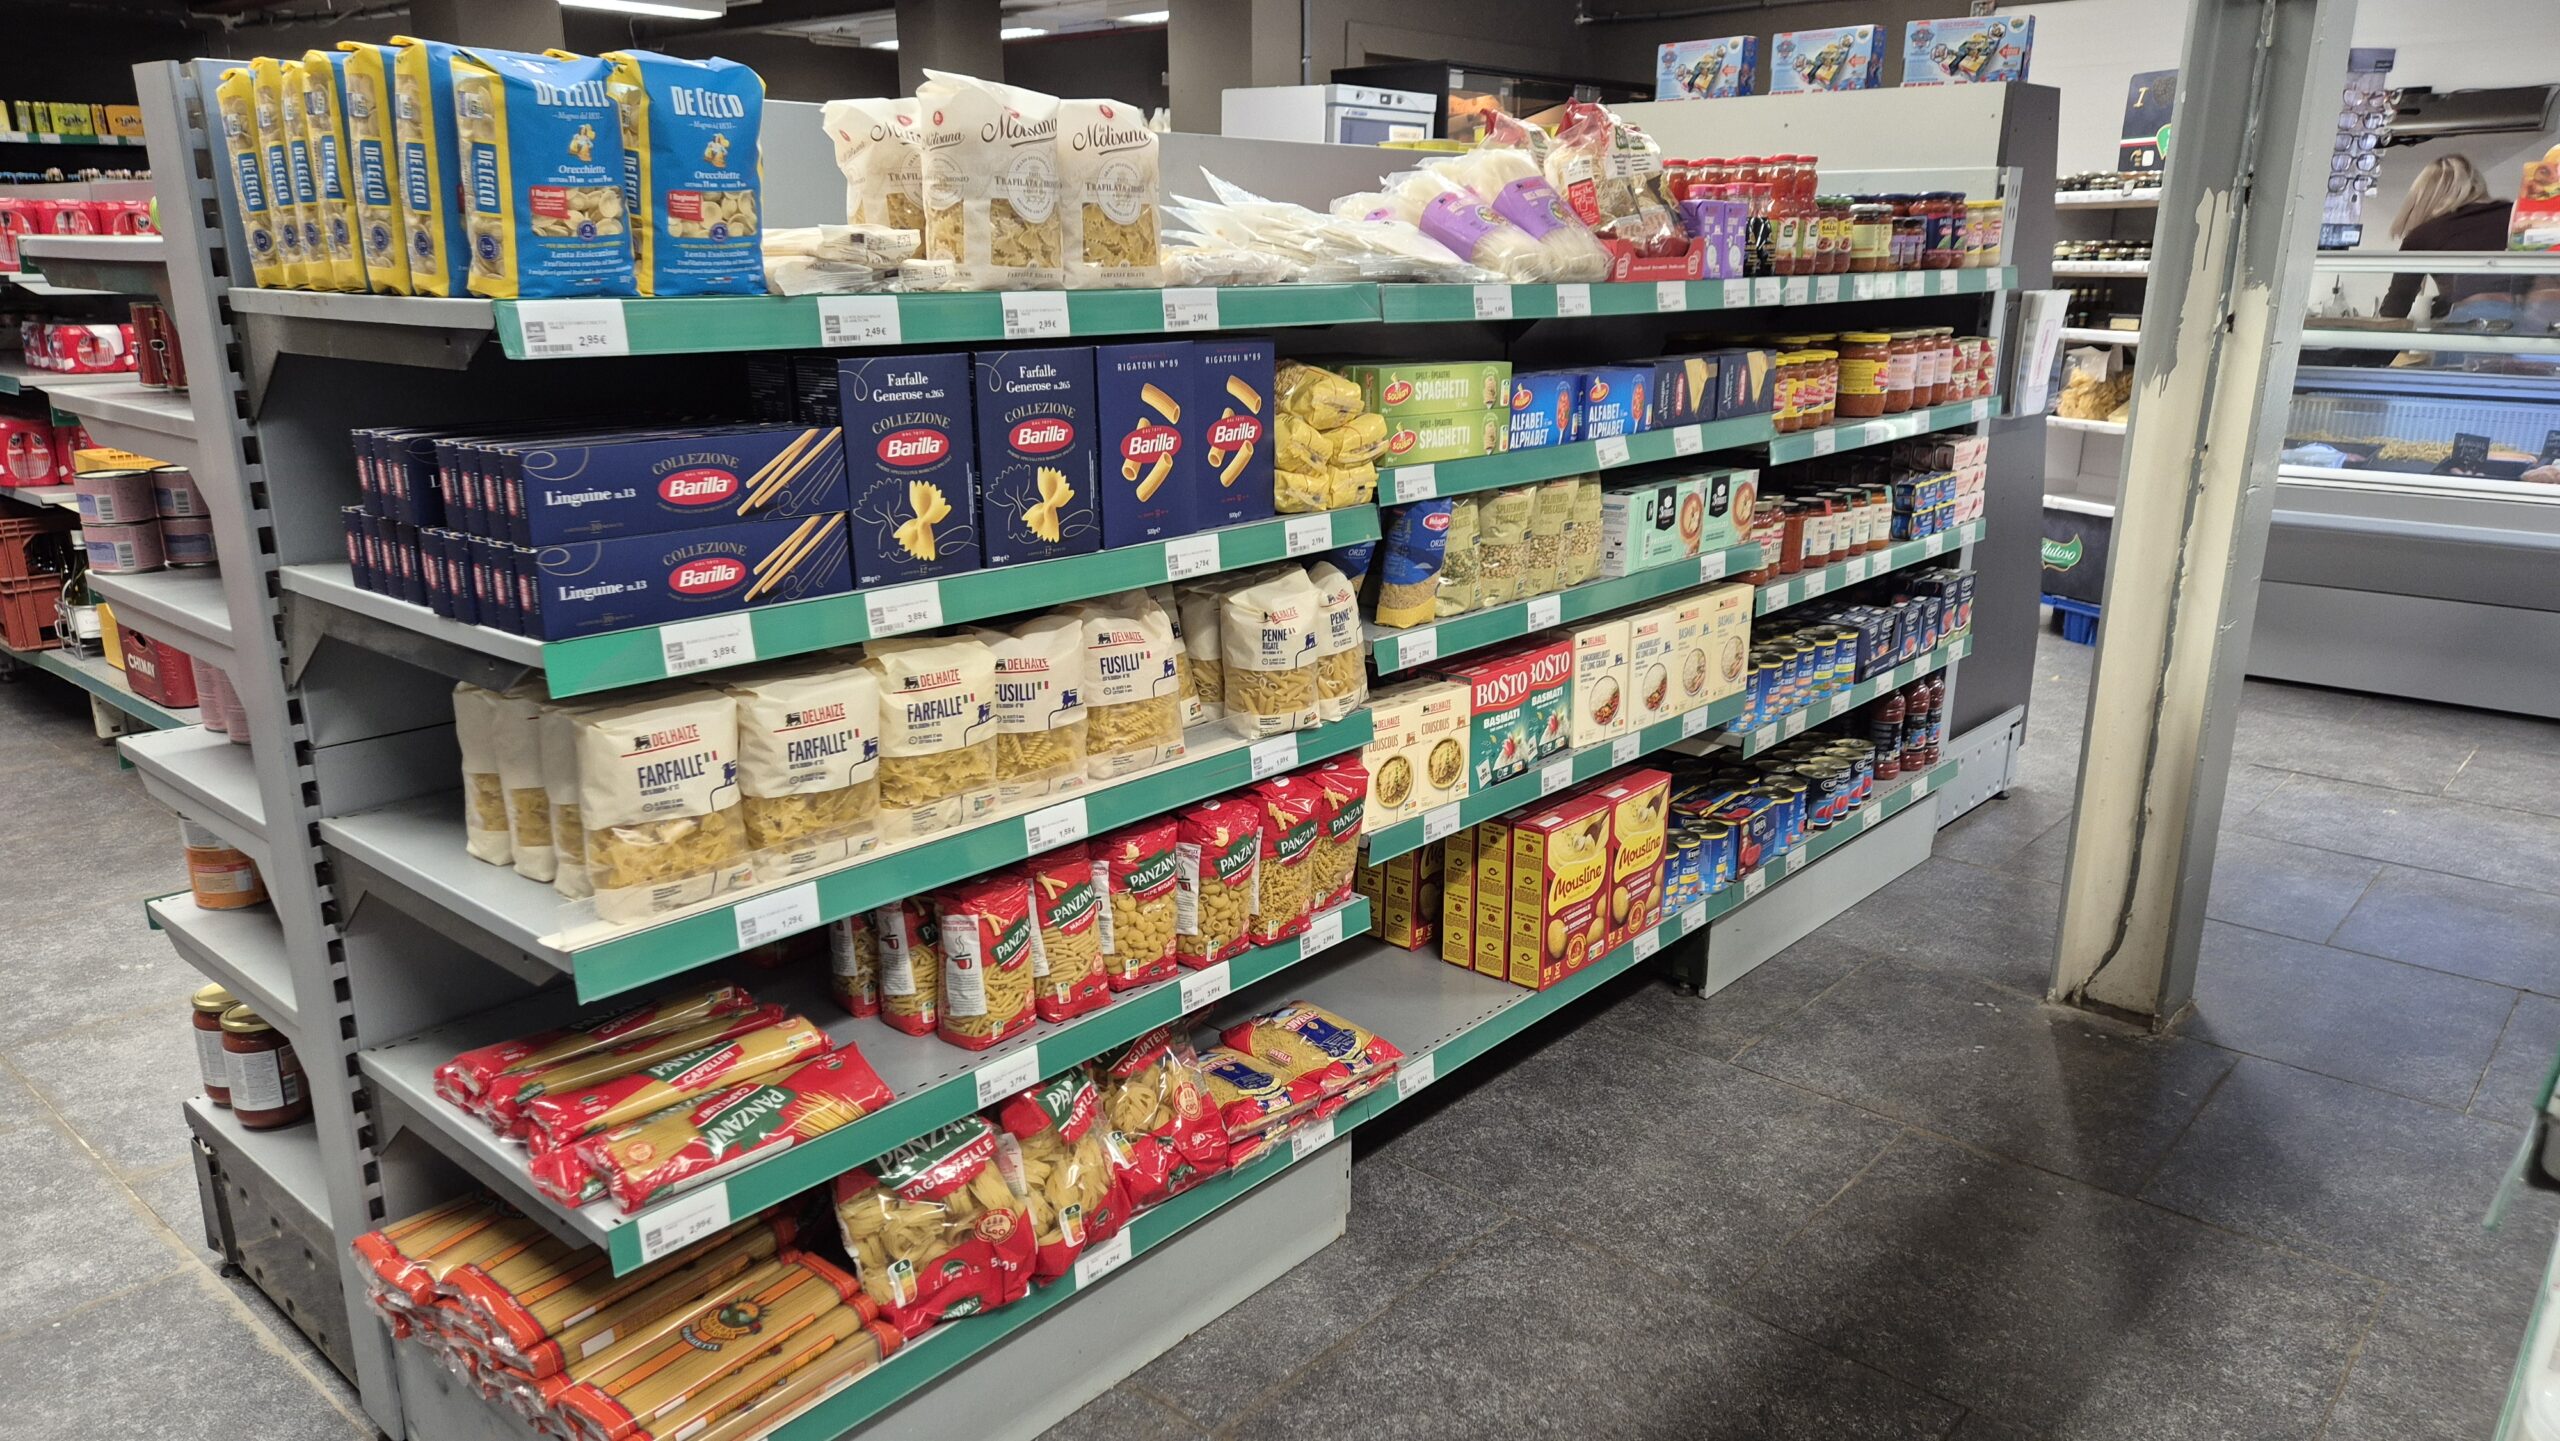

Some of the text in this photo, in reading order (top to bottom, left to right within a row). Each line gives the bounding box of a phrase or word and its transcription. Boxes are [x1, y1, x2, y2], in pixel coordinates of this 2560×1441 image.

[670, 85, 745, 119] DE CECCO
[1072, 123, 1150, 151] Molisana
[297, 162, 312, 196] CECCO
[327, 158, 339, 192] CECCO
[558, 164, 606, 174] Orecchiette
[693, 170, 740, 180] Orecchiette
[888, 172, 919, 182] TRAFIL
[244, 173, 262, 206] CECCO
[274, 166, 289, 200] CECCO
[366, 164, 385, 199] CECCO
[411, 166, 426, 203] CECCO
[479, 169, 496, 207] CECCO
[625, 175, 638, 208] CECCO
[1117, 361, 1156, 372] RIGATONI
[1205, 354, 1241, 364] RIGATONI
[887, 371, 928, 386] Farfalle
[1019, 364, 1057, 379] Farfalle
[873, 388, 945, 402] Generose n.265
[1006, 380, 1071, 393] Generose n.265
[1415, 379, 1470, 401] SPAGHETTI
[871, 411, 951, 435] COLLEZIONE
[1004, 401, 1077, 425] COLLEZIONE
[1510, 411, 1545, 431] ALFABET
[1589, 403, 1620, 423] ALFABET
[1018, 424, 1068, 446] Barilla
[1214, 423, 1257, 443] Barilla
[1419, 425, 1470, 450] SPAGHETTI
[1509, 428, 1549, 450] ALPHABET
[1588, 419, 1625, 441] ALPHABET
[886, 434, 943, 458] Barilla
[1129, 433, 1176, 456] Barilla
[652, 453, 740, 475] COLLEZIONE
[545, 488, 637, 508] Linguine n.13
[668, 477, 732, 498] Barilla
[663, 542, 748, 567] COLLEZIONE
[679, 566, 740, 588] Barilla
[559, 581, 648, 602] Linguine n.13
[1330, 609, 1350, 625] PENNE
[1111, 631, 1145, 643] DELHAIZE
[1262, 628, 1287, 642] PENNE
[1262, 641, 1279, 651] RIGATE
[1007, 657, 1050, 671] DELHAIZE
[1100, 652, 1139, 675] FUSILLI
[920, 668, 960, 688] DELHAIZE
[1476, 671, 1528, 707] BOSTO
[1531, 687, 1564, 706] BASMATI
[802, 703, 846, 724] DELHAIZE
[907, 695, 963, 723] FARFALLE
[1483, 708, 1520, 729] BASMATI
[650, 723, 700, 748] DELHAIZE
[1421, 718, 1450, 736] COUSCOUS
[787, 731, 848, 762] FARFALLE
[1368, 735, 1399, 753] COUSCOUS
[637, 753, 706, 789] FARFALLE
[1281, 822, 1318, 855] PANZANI
[1619, 836, 1661, 871] Mousline
[1130, 853, 1176, 887] PANZANI
[1554, 865, 1602, 902] Mousline
[1053, 884, 1093, 922] PANZANI
[1119, 1027, 1170, 1073] TAGLIATELLE
[683, 1049, 735, 1085] CAPELLINI
[699, 1087, 750, 1119] CAPELLINI
[703, 1087, 787, 1152] PANZANI
